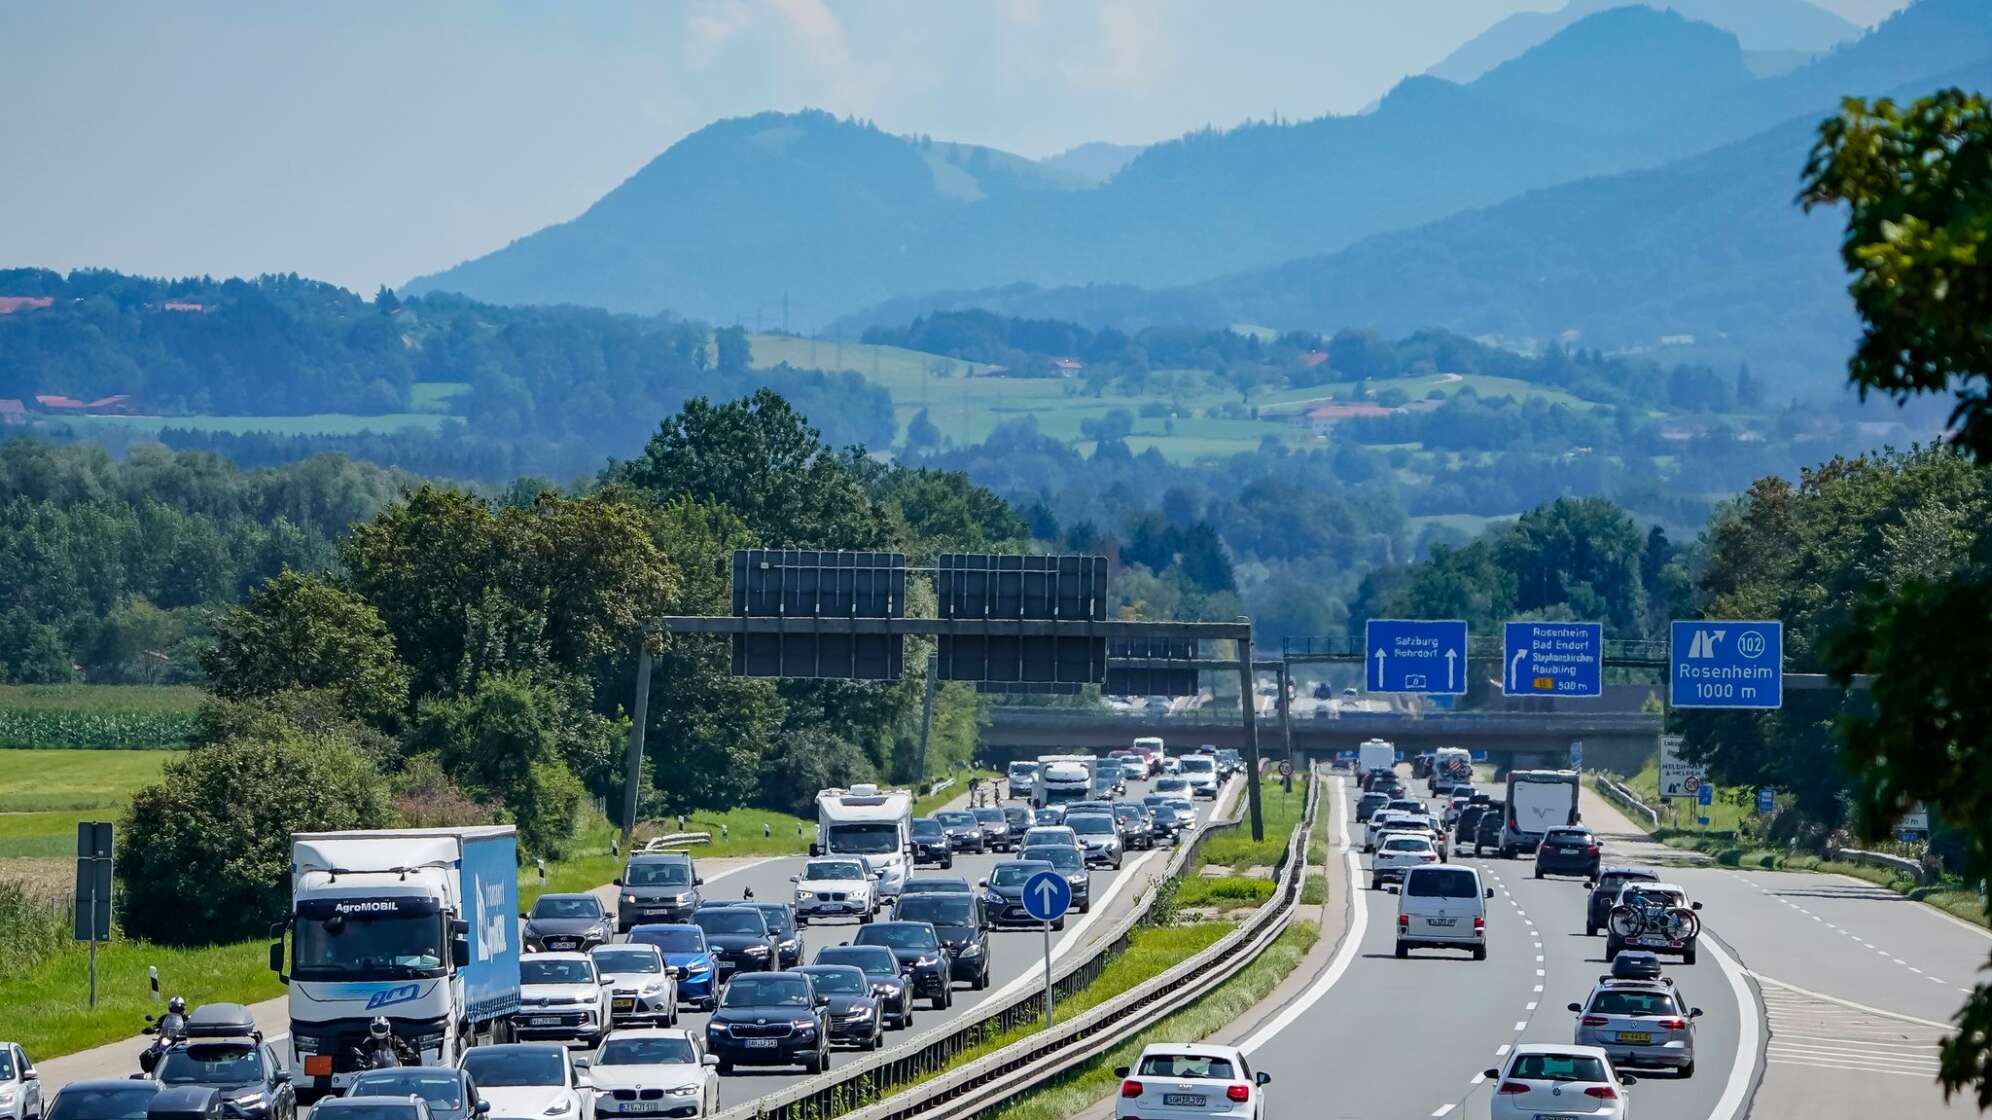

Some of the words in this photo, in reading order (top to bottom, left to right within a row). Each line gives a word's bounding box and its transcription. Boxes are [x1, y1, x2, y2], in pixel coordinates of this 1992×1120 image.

[1395, 636, 1439, 648] Salzburg
[1533, 641, 1552, 649] Bad
[1556, 641, 1589, 650] Endorf
[1741, 638, 1761, 652] 102
[1394, 649, 1438, 657] Rohrdorf
[1533, 665, 1577, 676] Raubling
[1680, 664, 1773, 678] Rosenheim
[1697, 684, 1733, 698] 1000
[1742, 687, 1756, 698] m
[335, 902, 399, 914] AgroMOBIL
